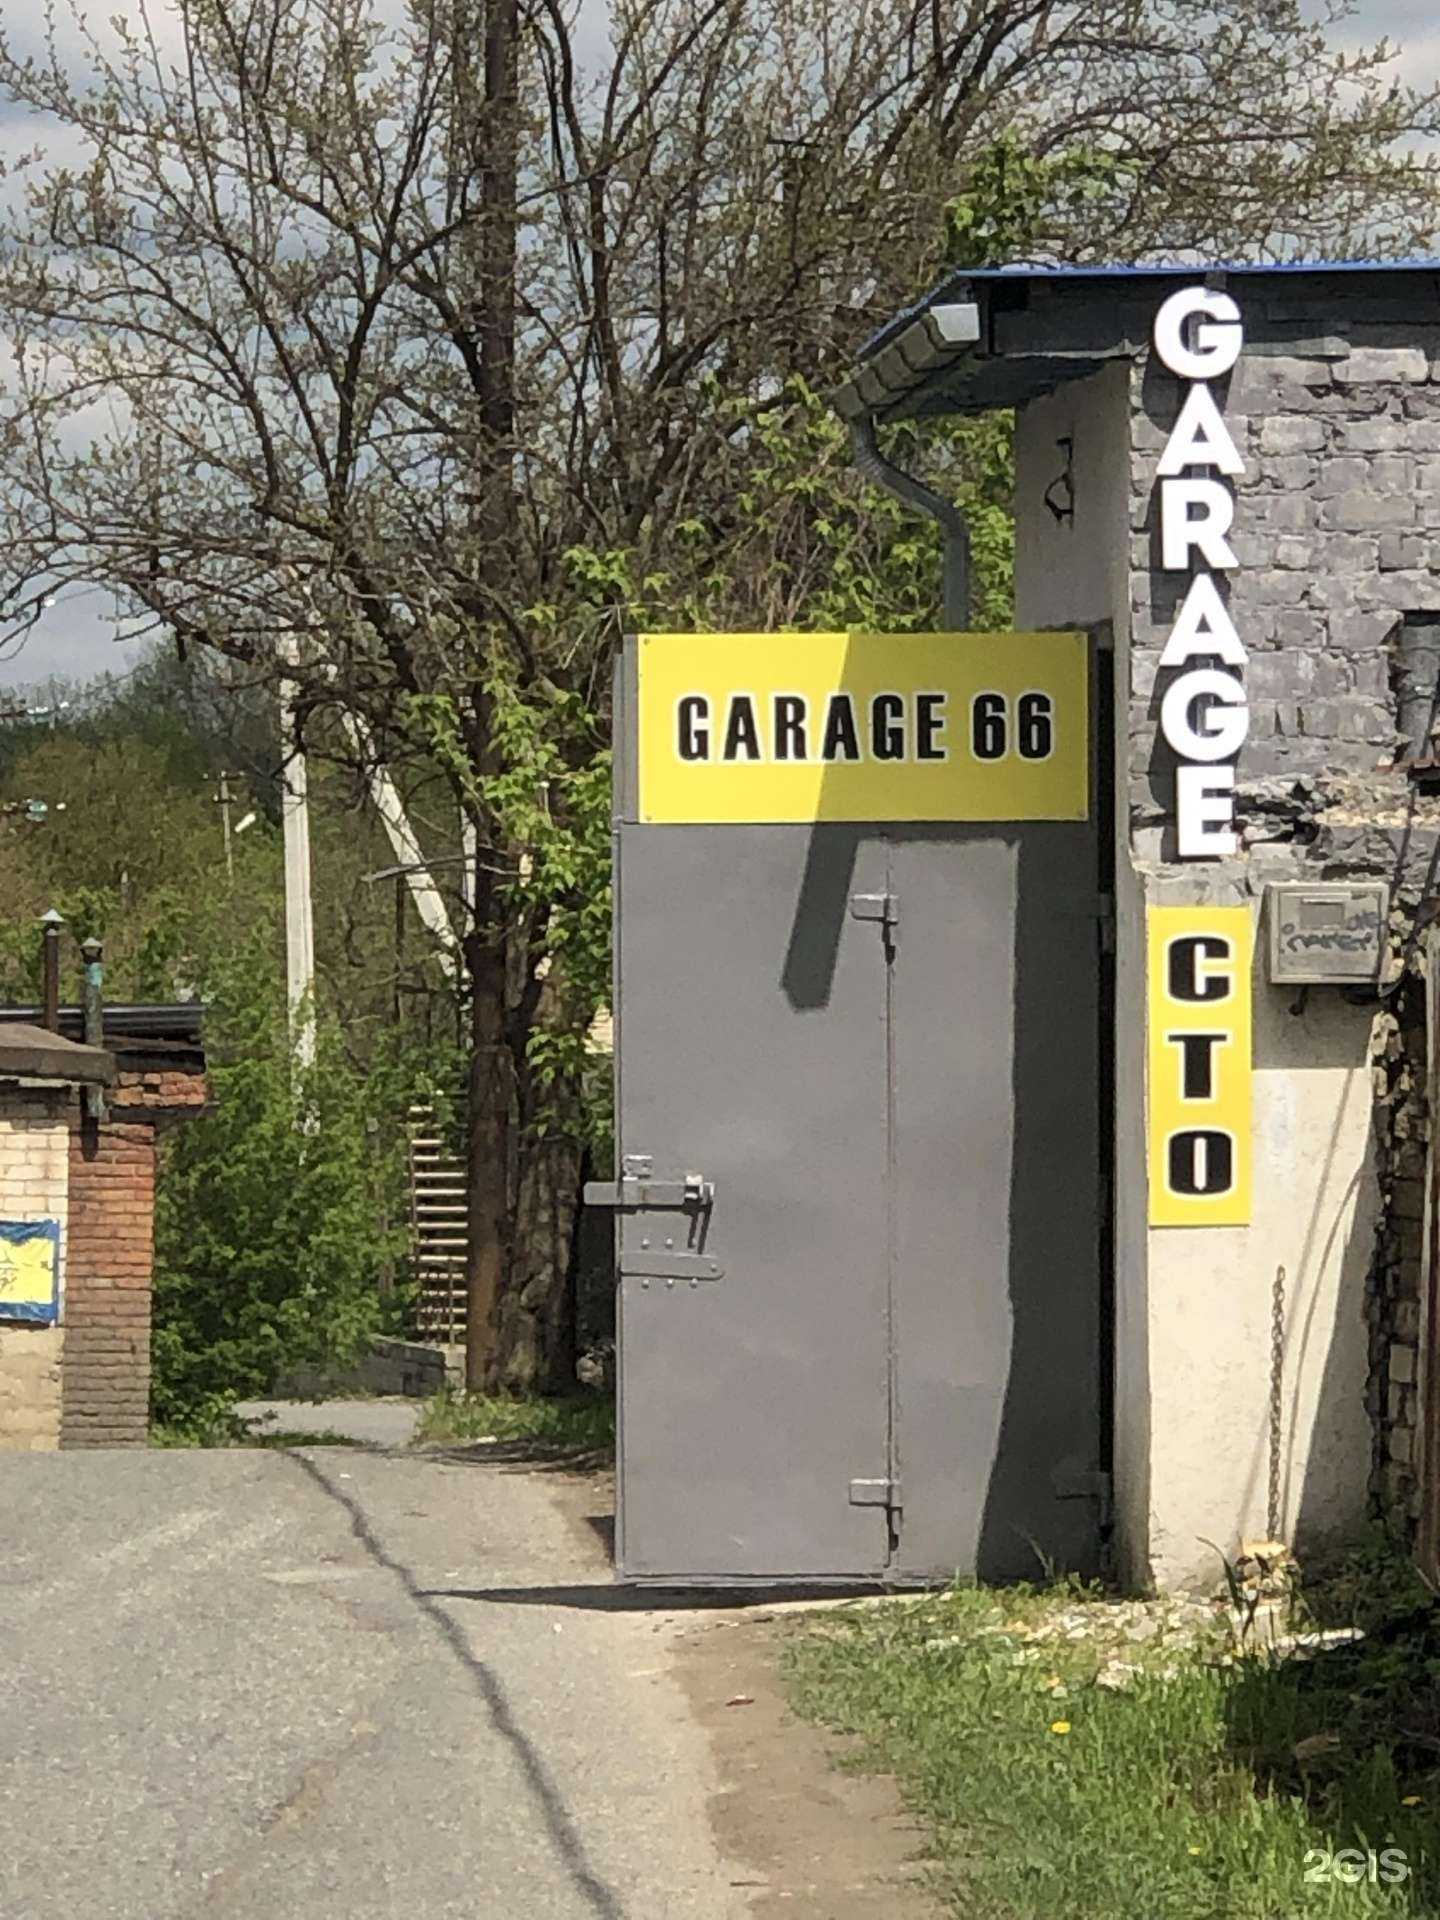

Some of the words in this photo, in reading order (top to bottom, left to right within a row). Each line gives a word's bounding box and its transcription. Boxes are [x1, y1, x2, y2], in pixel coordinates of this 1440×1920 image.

[1154, 286, 1250, 857] GARAGE
[677, 694, 947, 761] GARAGE
[972, 692, 1052, 760] 66
[1167, 934, 1233, 1197] СТО
